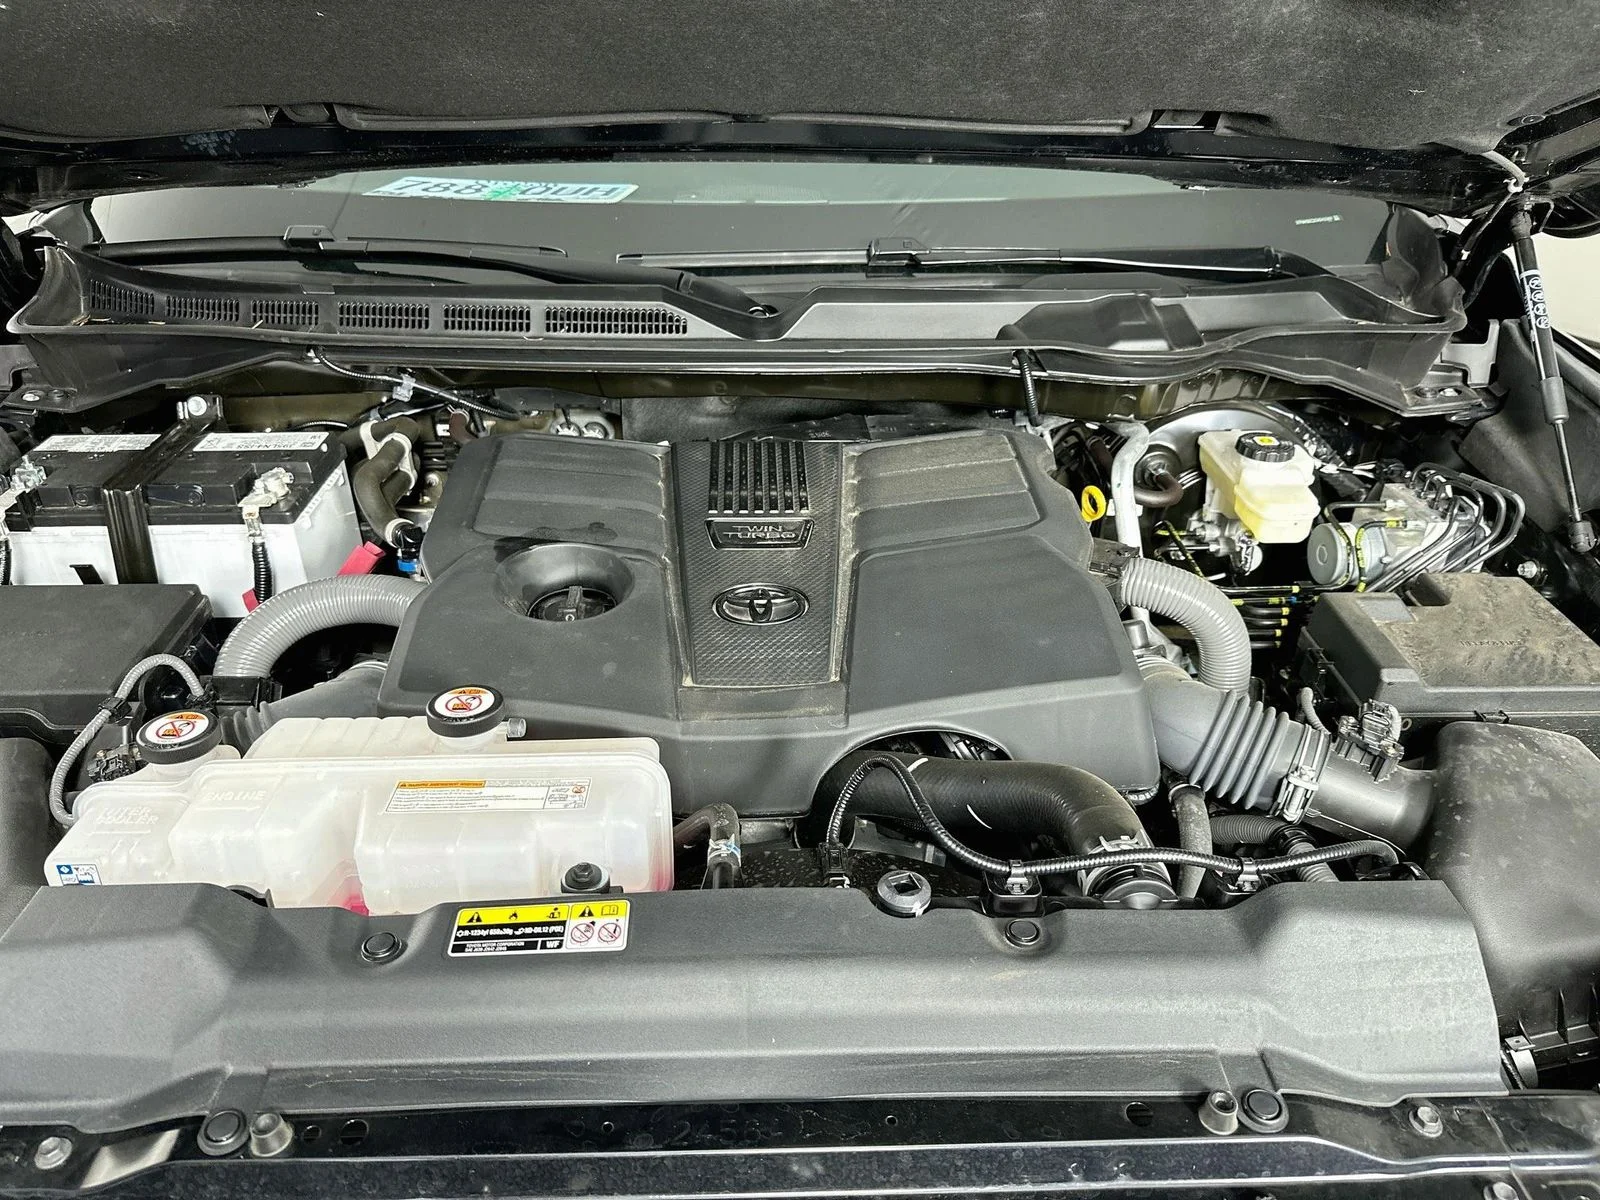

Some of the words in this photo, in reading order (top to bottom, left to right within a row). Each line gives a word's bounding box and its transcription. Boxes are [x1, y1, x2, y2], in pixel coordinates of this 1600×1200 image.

[394, 180, 489, 195] 788
[723, 531, 796, 539] TURBO
[206, 790, 267, 801] ENGINE
[546, 940, 560, 949] WF
